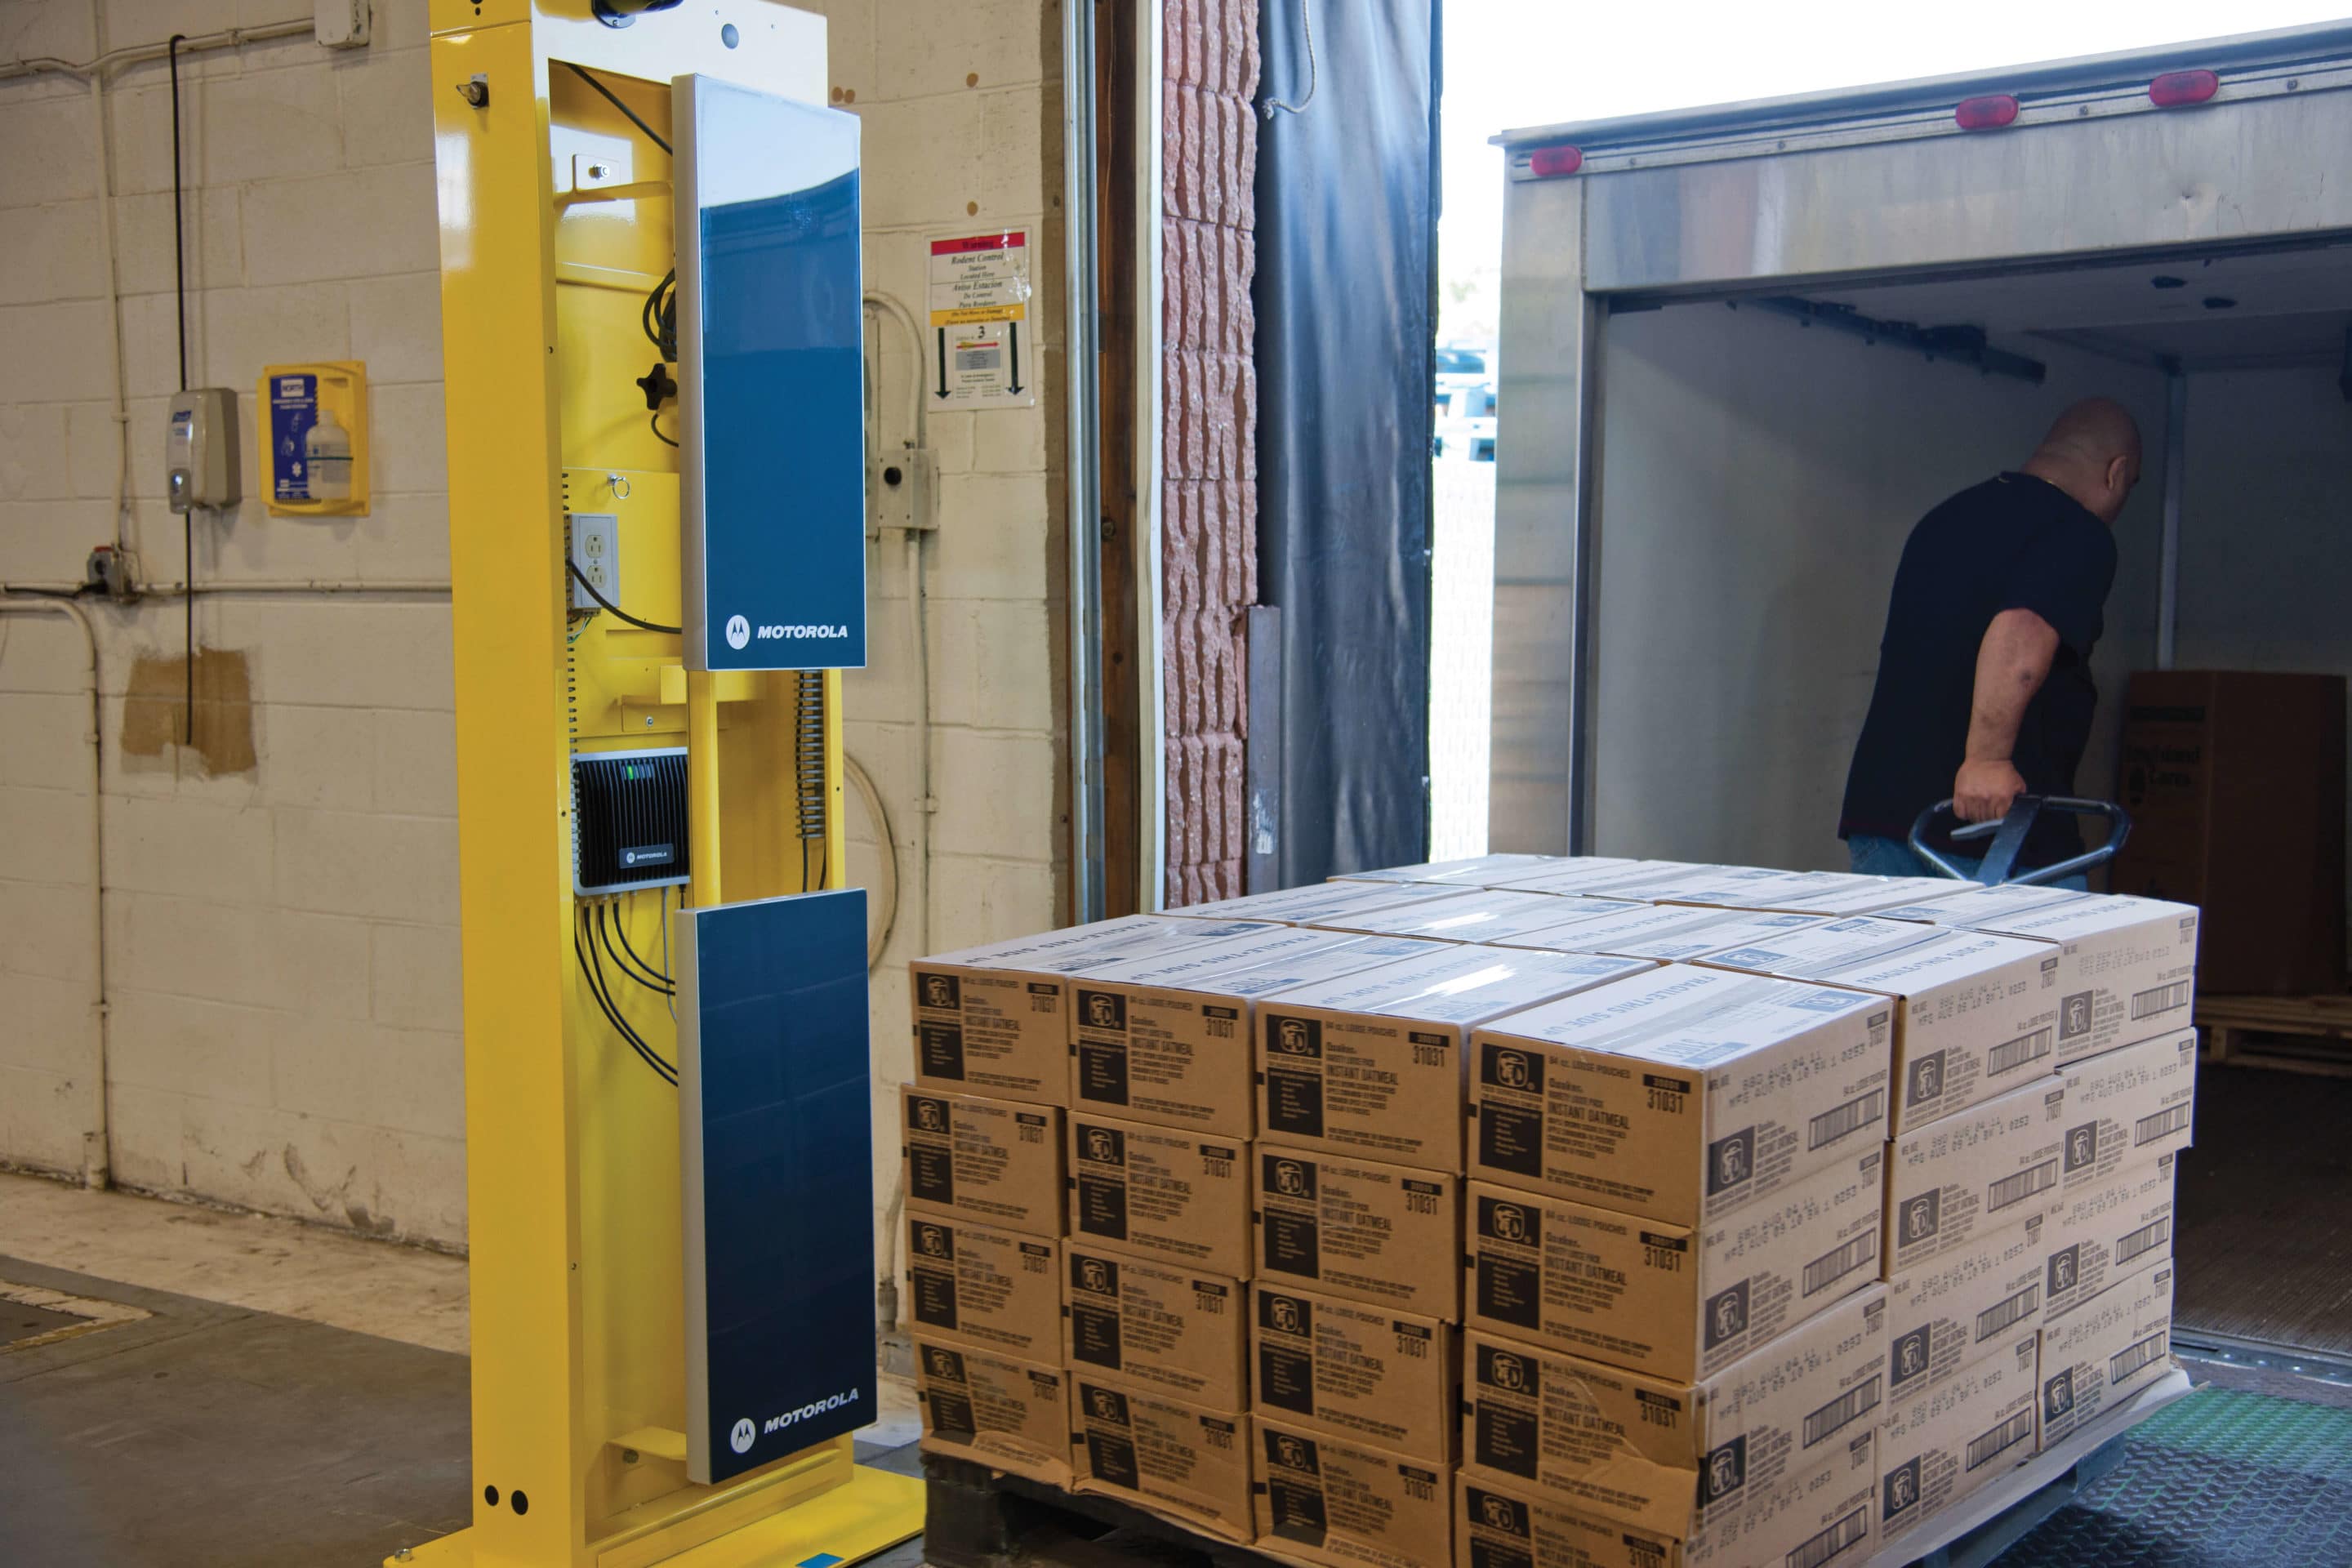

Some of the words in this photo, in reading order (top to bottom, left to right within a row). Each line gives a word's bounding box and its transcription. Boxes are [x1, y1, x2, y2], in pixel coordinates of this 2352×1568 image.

[962, 240, 994, 249] Warning
[951, 254, 977, 265] Rodent
[978, 252, 1004, 263] Control
[969, 265, 987, 273] Station
[978, 325, 986, 340] 3
[757, 625, 849, 639] MOTOROLA
[635, 851, 668, 861] MOTOROLA
[1566, 1012, 1612, 1028] SIDE
[1541, 1025, 1570, 1036] UP
[1413, 1045, 1445, 1067] 31031
[1841, 1042, 1866, 1062] 0253
[1597, 1064, 1630, 1079] POUCHES
[1792, 1056, 1805, 1071] 04
[1647, 1089, 1684, 1115] 31031
[1548, 1101, 1584, 1120] INSTANT
[1588, 1109, 1629, 1129] OATMEAL
[1406, 1192, 1437, 1216] 31031
[1833, 1184, 1857, 1206] 0253
[1785, 1204, 1798, 1218] 04
[1593, 1220, 1626, 1236] POUCHES
[1644, 1245, 1681, 1272] 31031
[1544, 1254, 1581, 1275] INSTANT
[1584, 1263, 1626, 1285] OATMEAL
[1397, 1334, 1426, 1359] 31031
[764, 1387, 859, 1435] MOTOROLA
[1543, 1404, 1579, 1427] INSTANT
[1641, 1402, 1677, 1431] 31031
[1404, 1477, 1435, 1501] 31031
